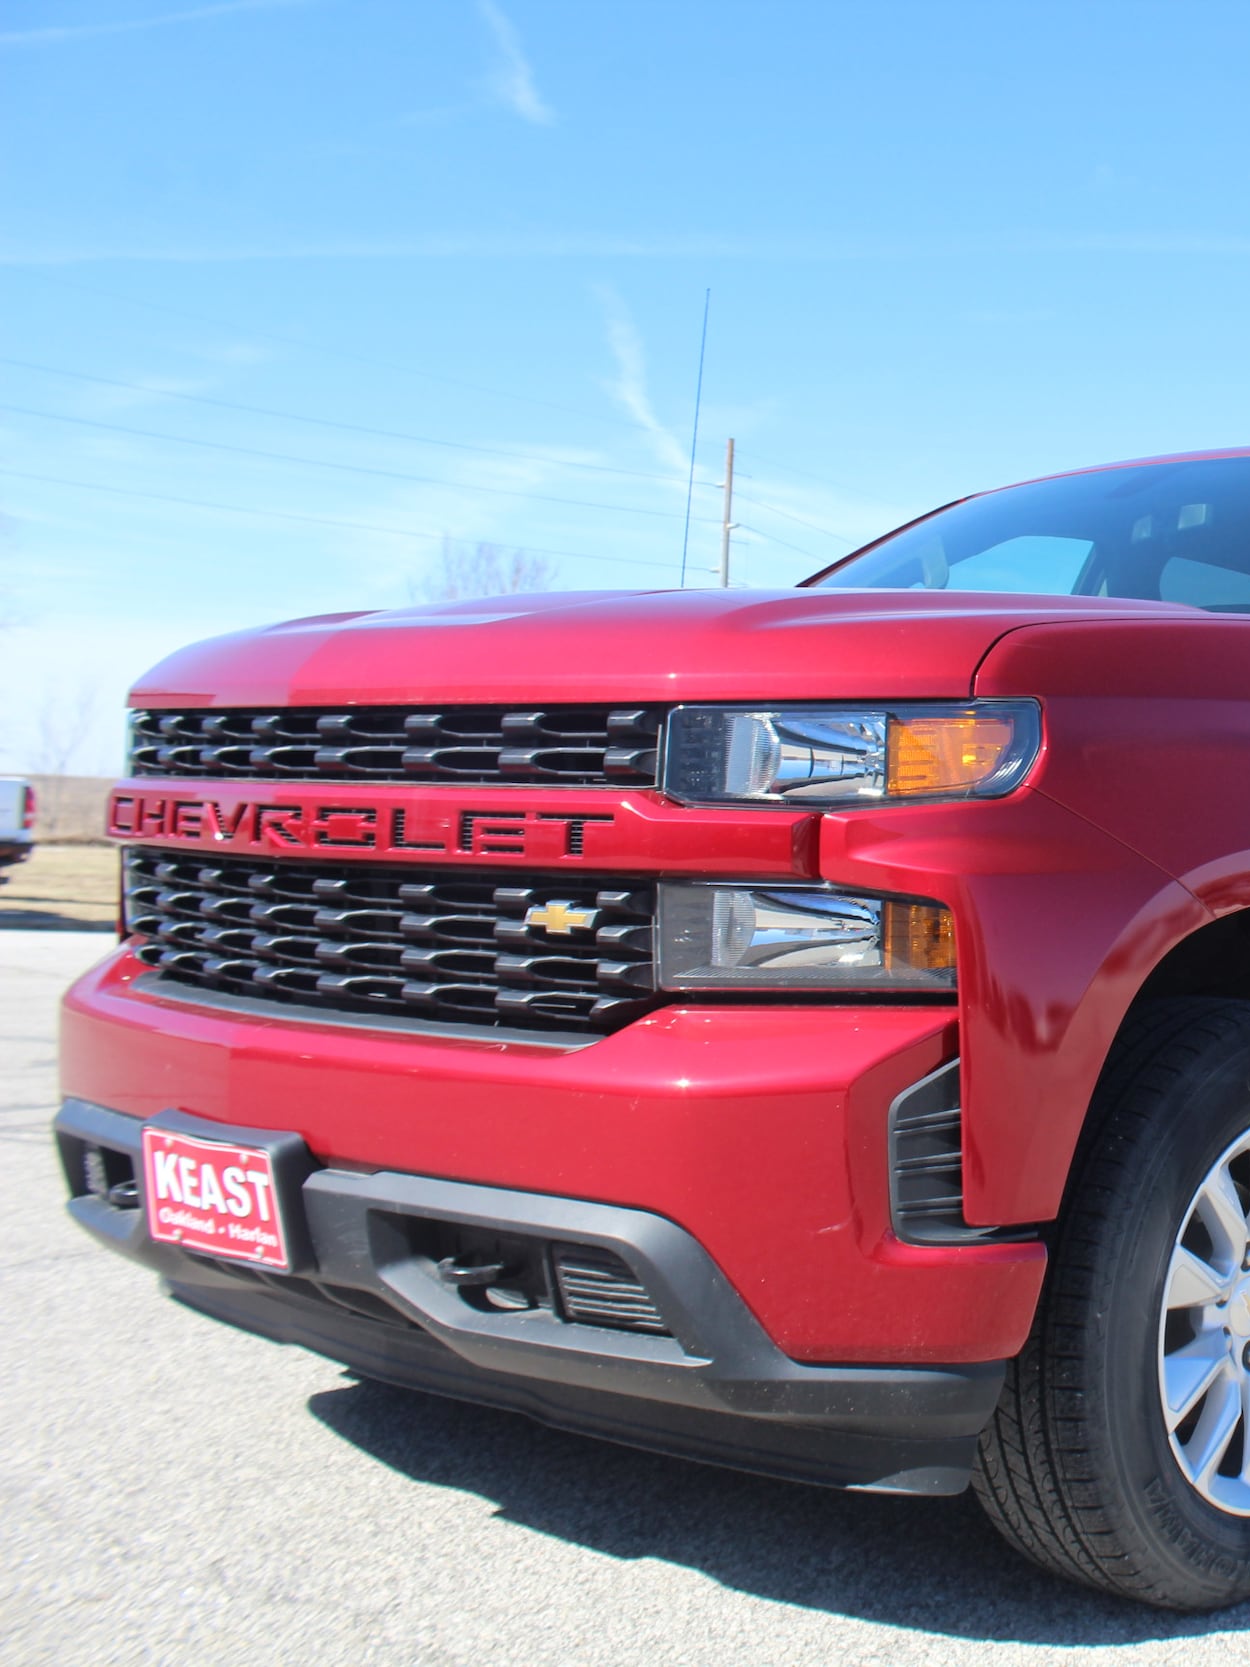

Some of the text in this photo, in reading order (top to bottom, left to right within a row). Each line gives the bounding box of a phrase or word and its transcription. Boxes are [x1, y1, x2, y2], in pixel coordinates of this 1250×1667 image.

[107, 795, 614, 858] CHEVROLET
[153, 1150, 270, 1221] KEAST
[158, 1207, 279, 1247] Oakland Harlan
